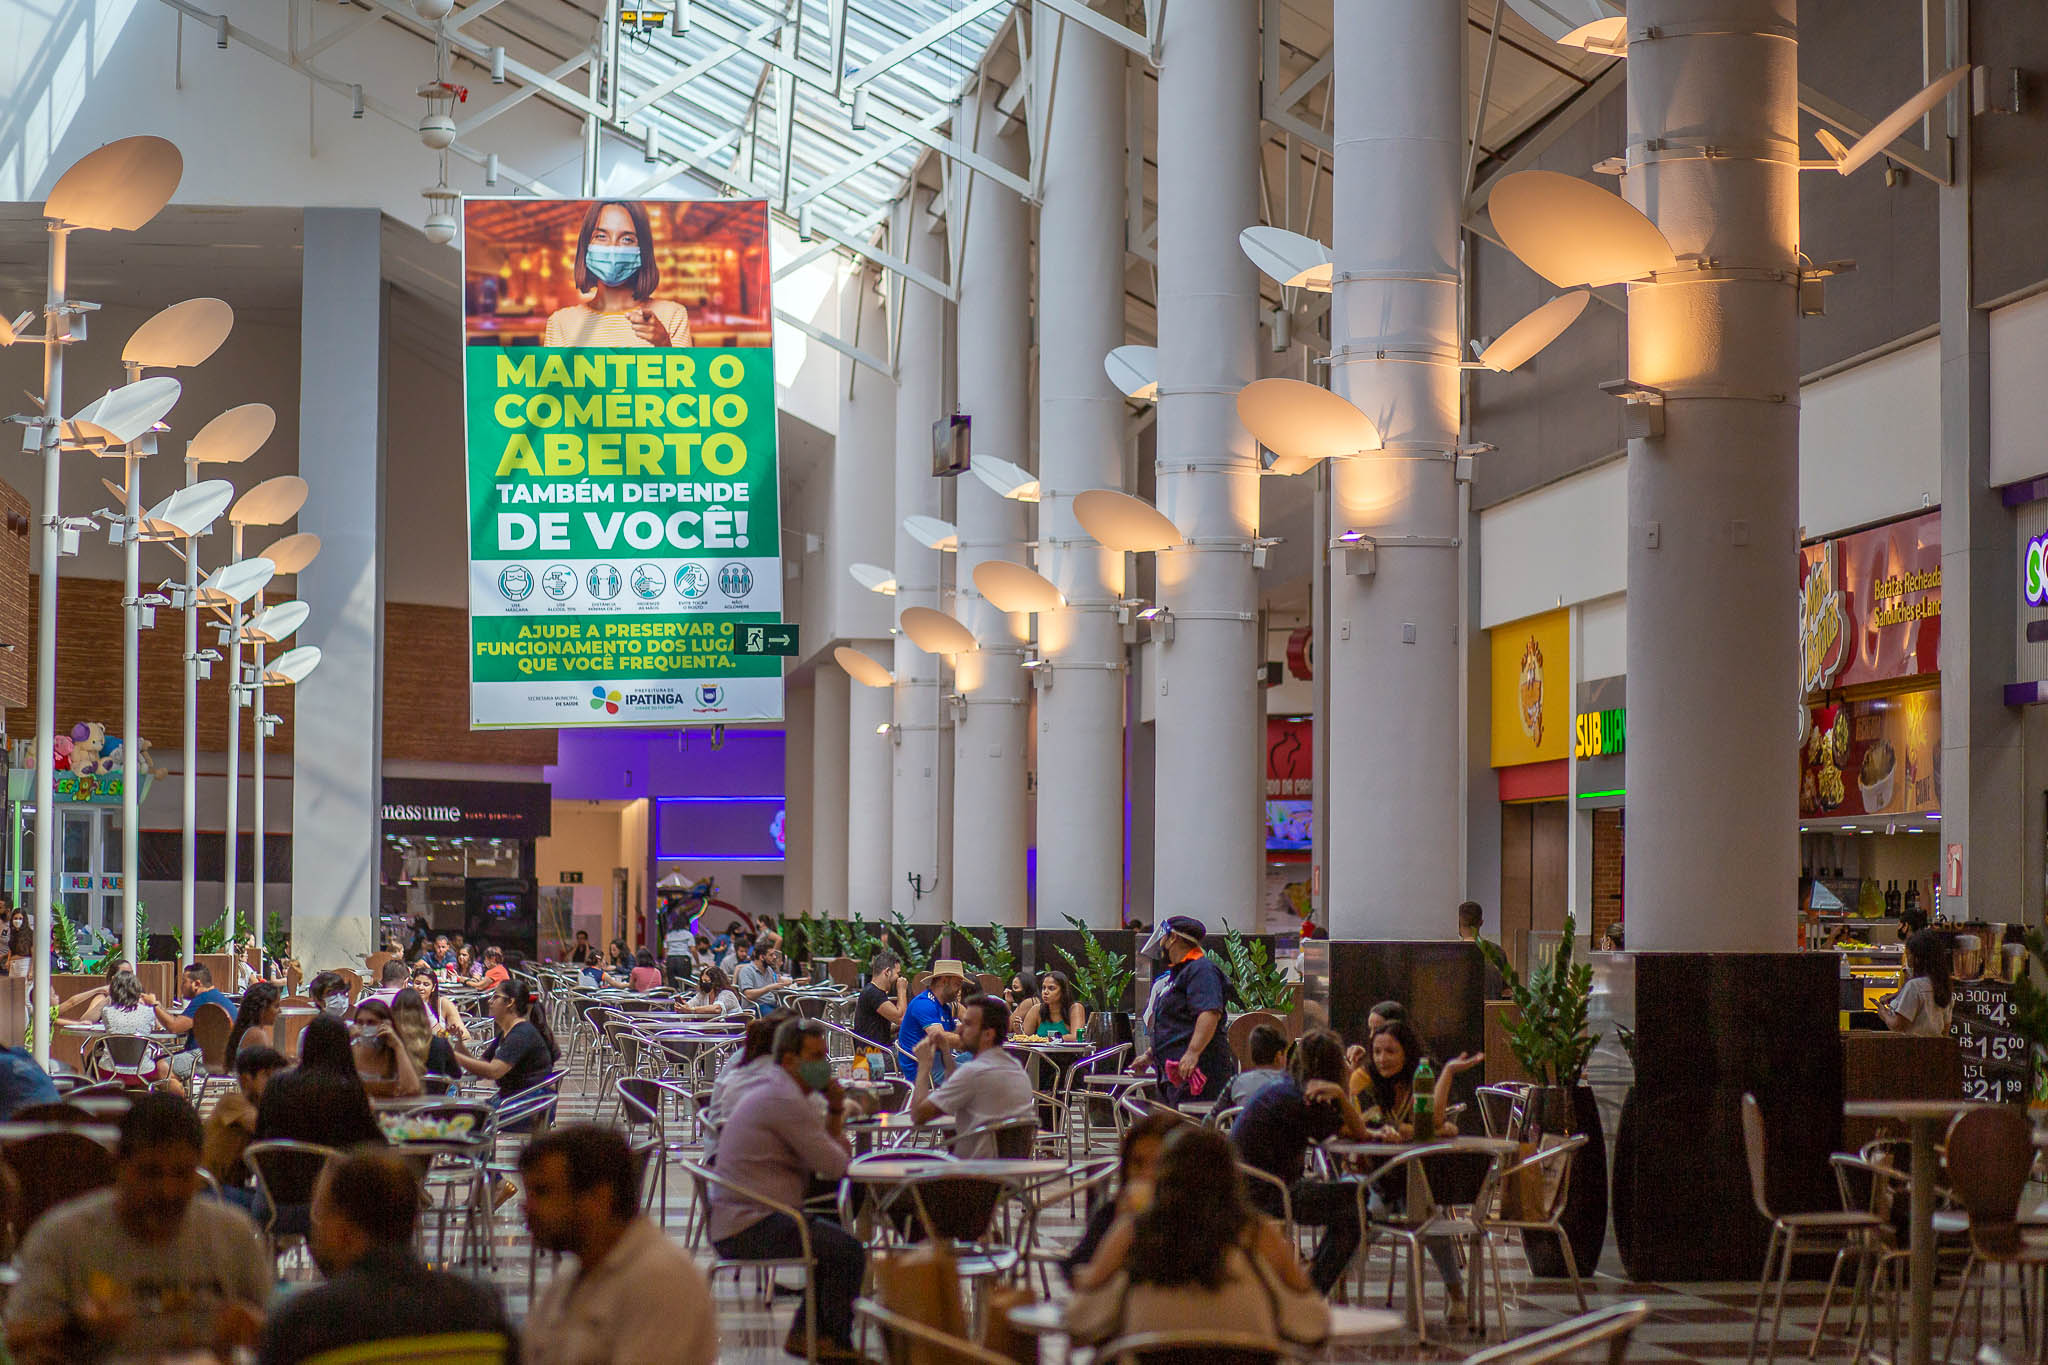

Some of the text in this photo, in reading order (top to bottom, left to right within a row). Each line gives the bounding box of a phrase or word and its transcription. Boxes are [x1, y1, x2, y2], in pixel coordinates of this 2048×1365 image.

[497, 354, 745, 388] MANTER O
[494, 388, 749, 428] COMÉRCIO
[495, 432, 748, 476] ABERTO
[495, 478, 750, 504] TAMBÉM DEPENDE
[497, 504, 750, 551] DE VOCÊ!
[1806, 544, 1830, 632] Maxi
[1874, 576, 1904, 601] Batatas
[518, 622, 734, 639] AJUDE A PRESERVAR O
[1806, 596, 1839, 685] Batatas
[476, 639, 642, 656] FUNCIONAMENTO
[647, 639, 686, 653] DOS
[518, 653, 736, 674] QUE VOCÊ FREQUENTA.
[1966, 990, 1990, 1002] 300
[1991, 991, 2008, 1003] ml
